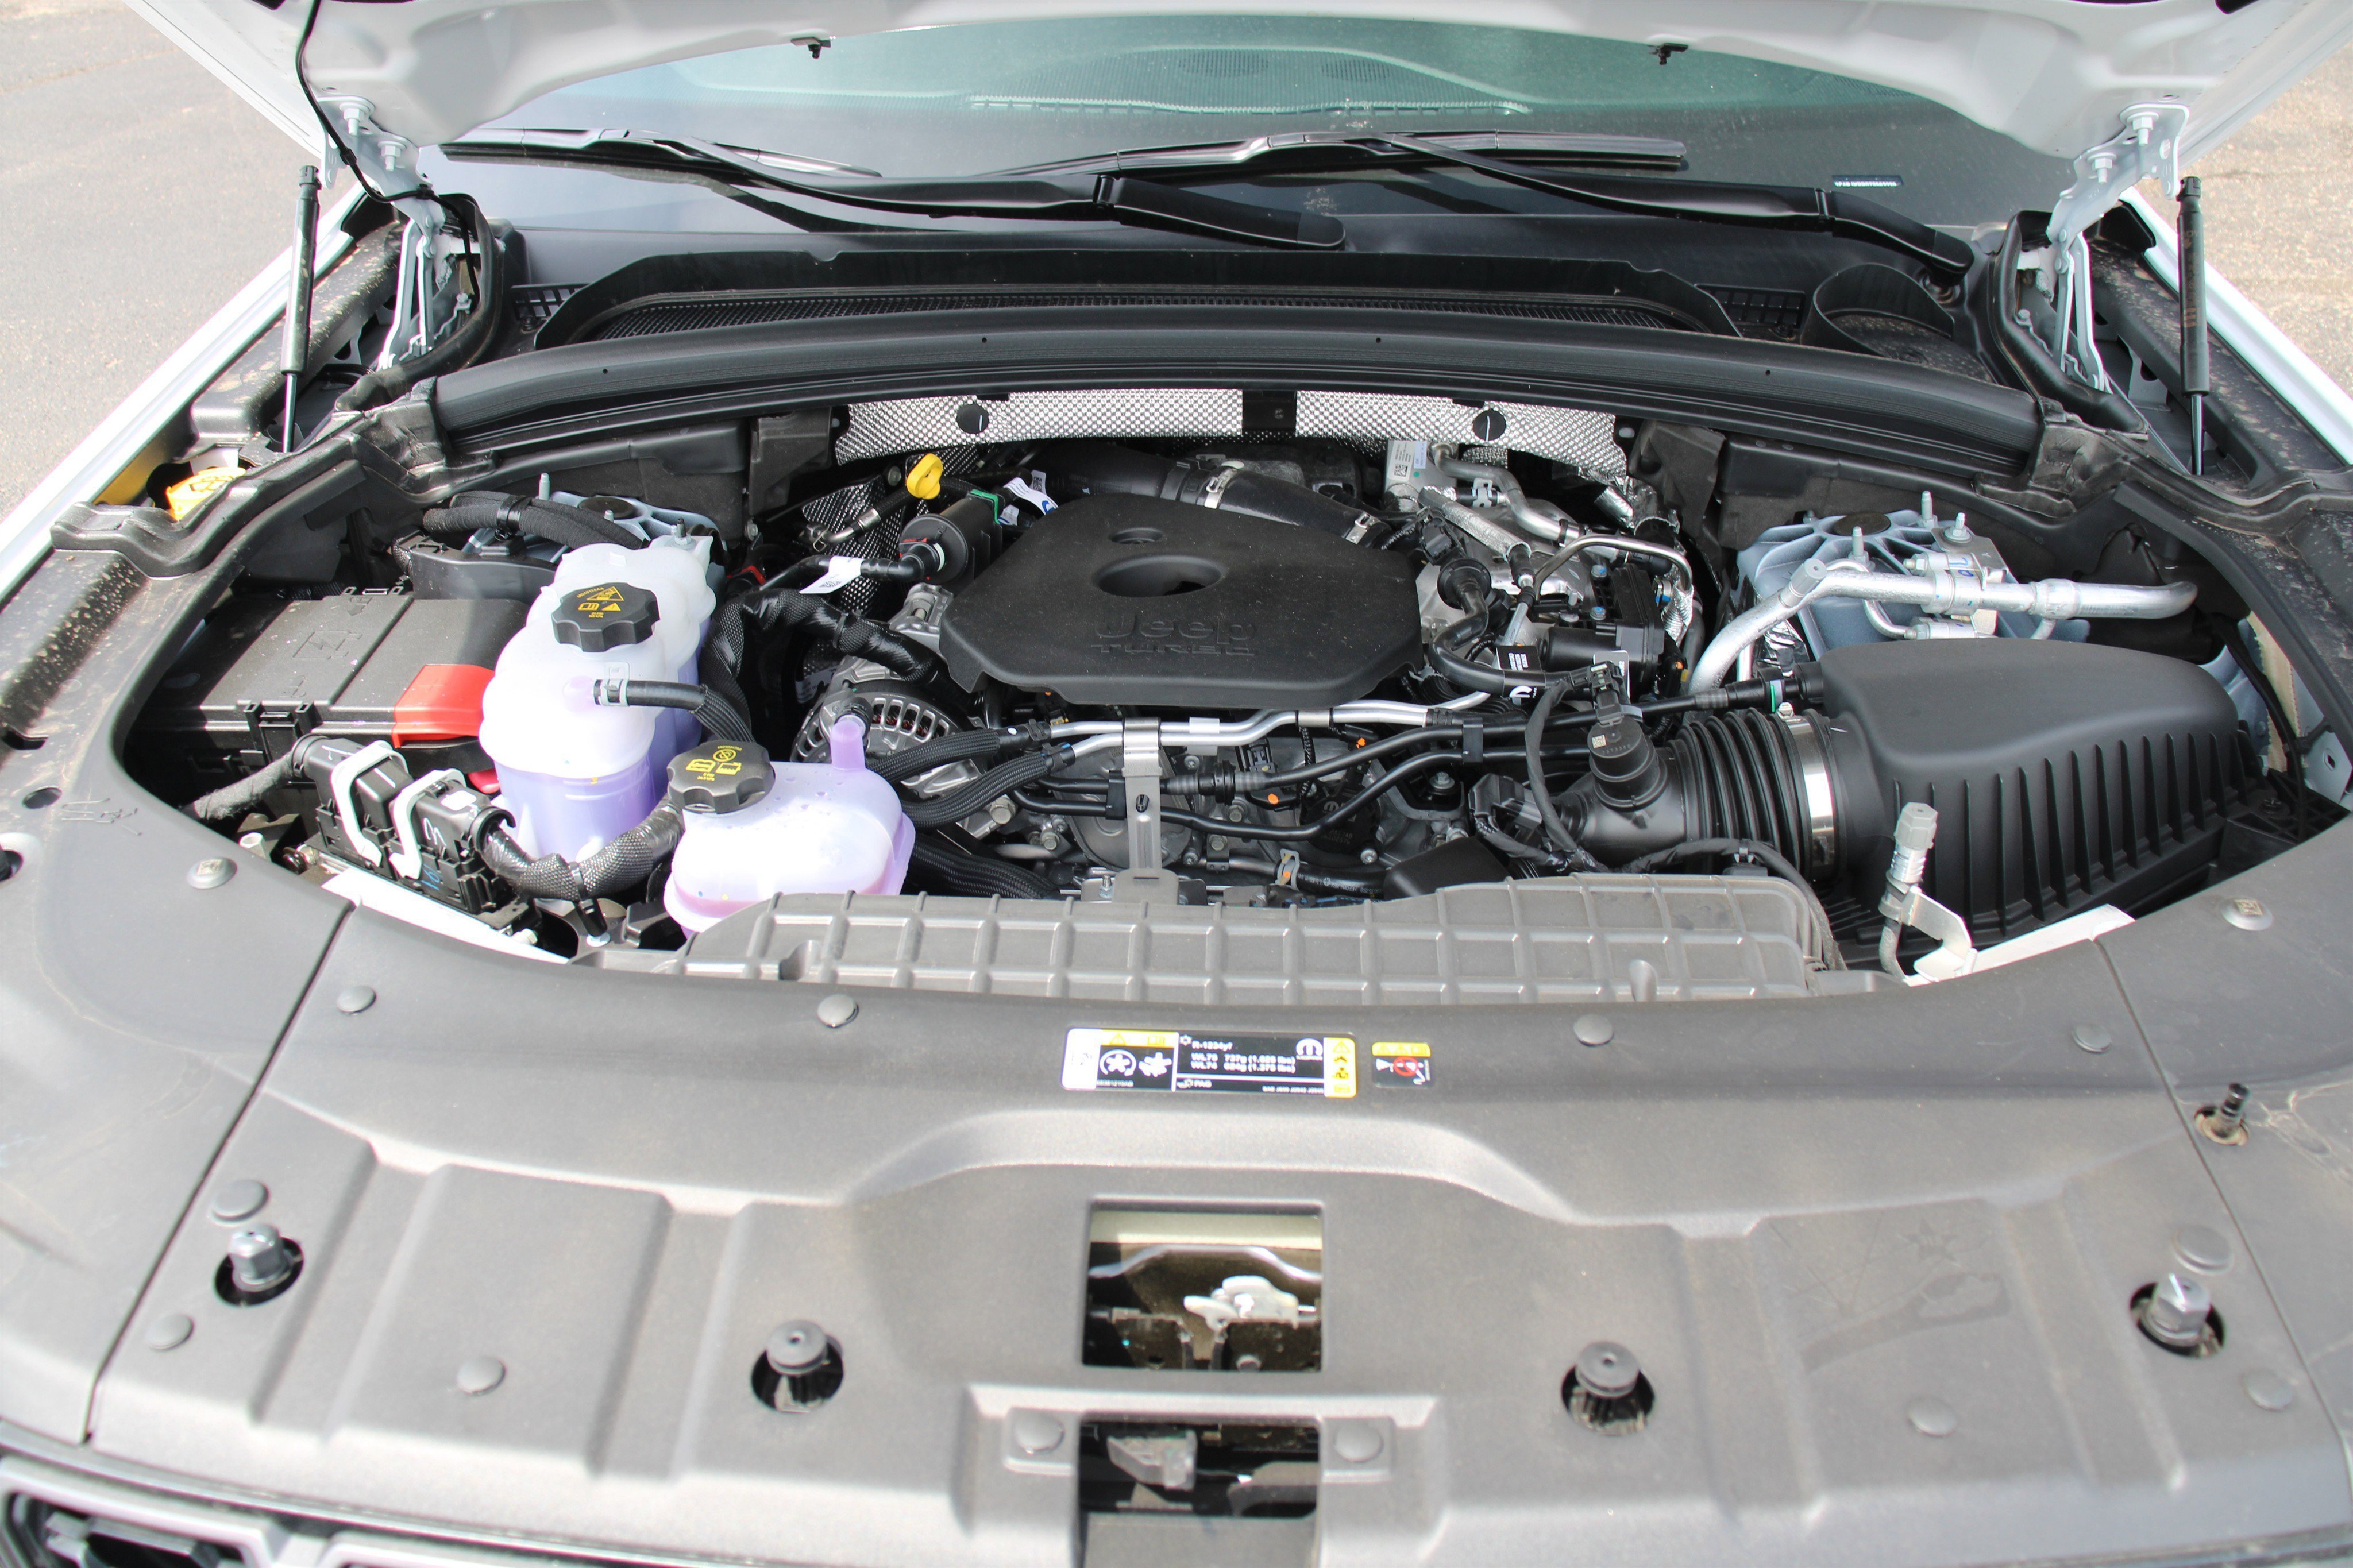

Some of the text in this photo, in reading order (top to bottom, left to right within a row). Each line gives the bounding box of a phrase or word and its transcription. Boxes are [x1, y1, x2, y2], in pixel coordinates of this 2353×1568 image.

[1094, 614, 1257, 645] Jeep
[1090, 644, 1256, 656] TURBO
[1191, 1041, 1233, 1052] R-1234yf
